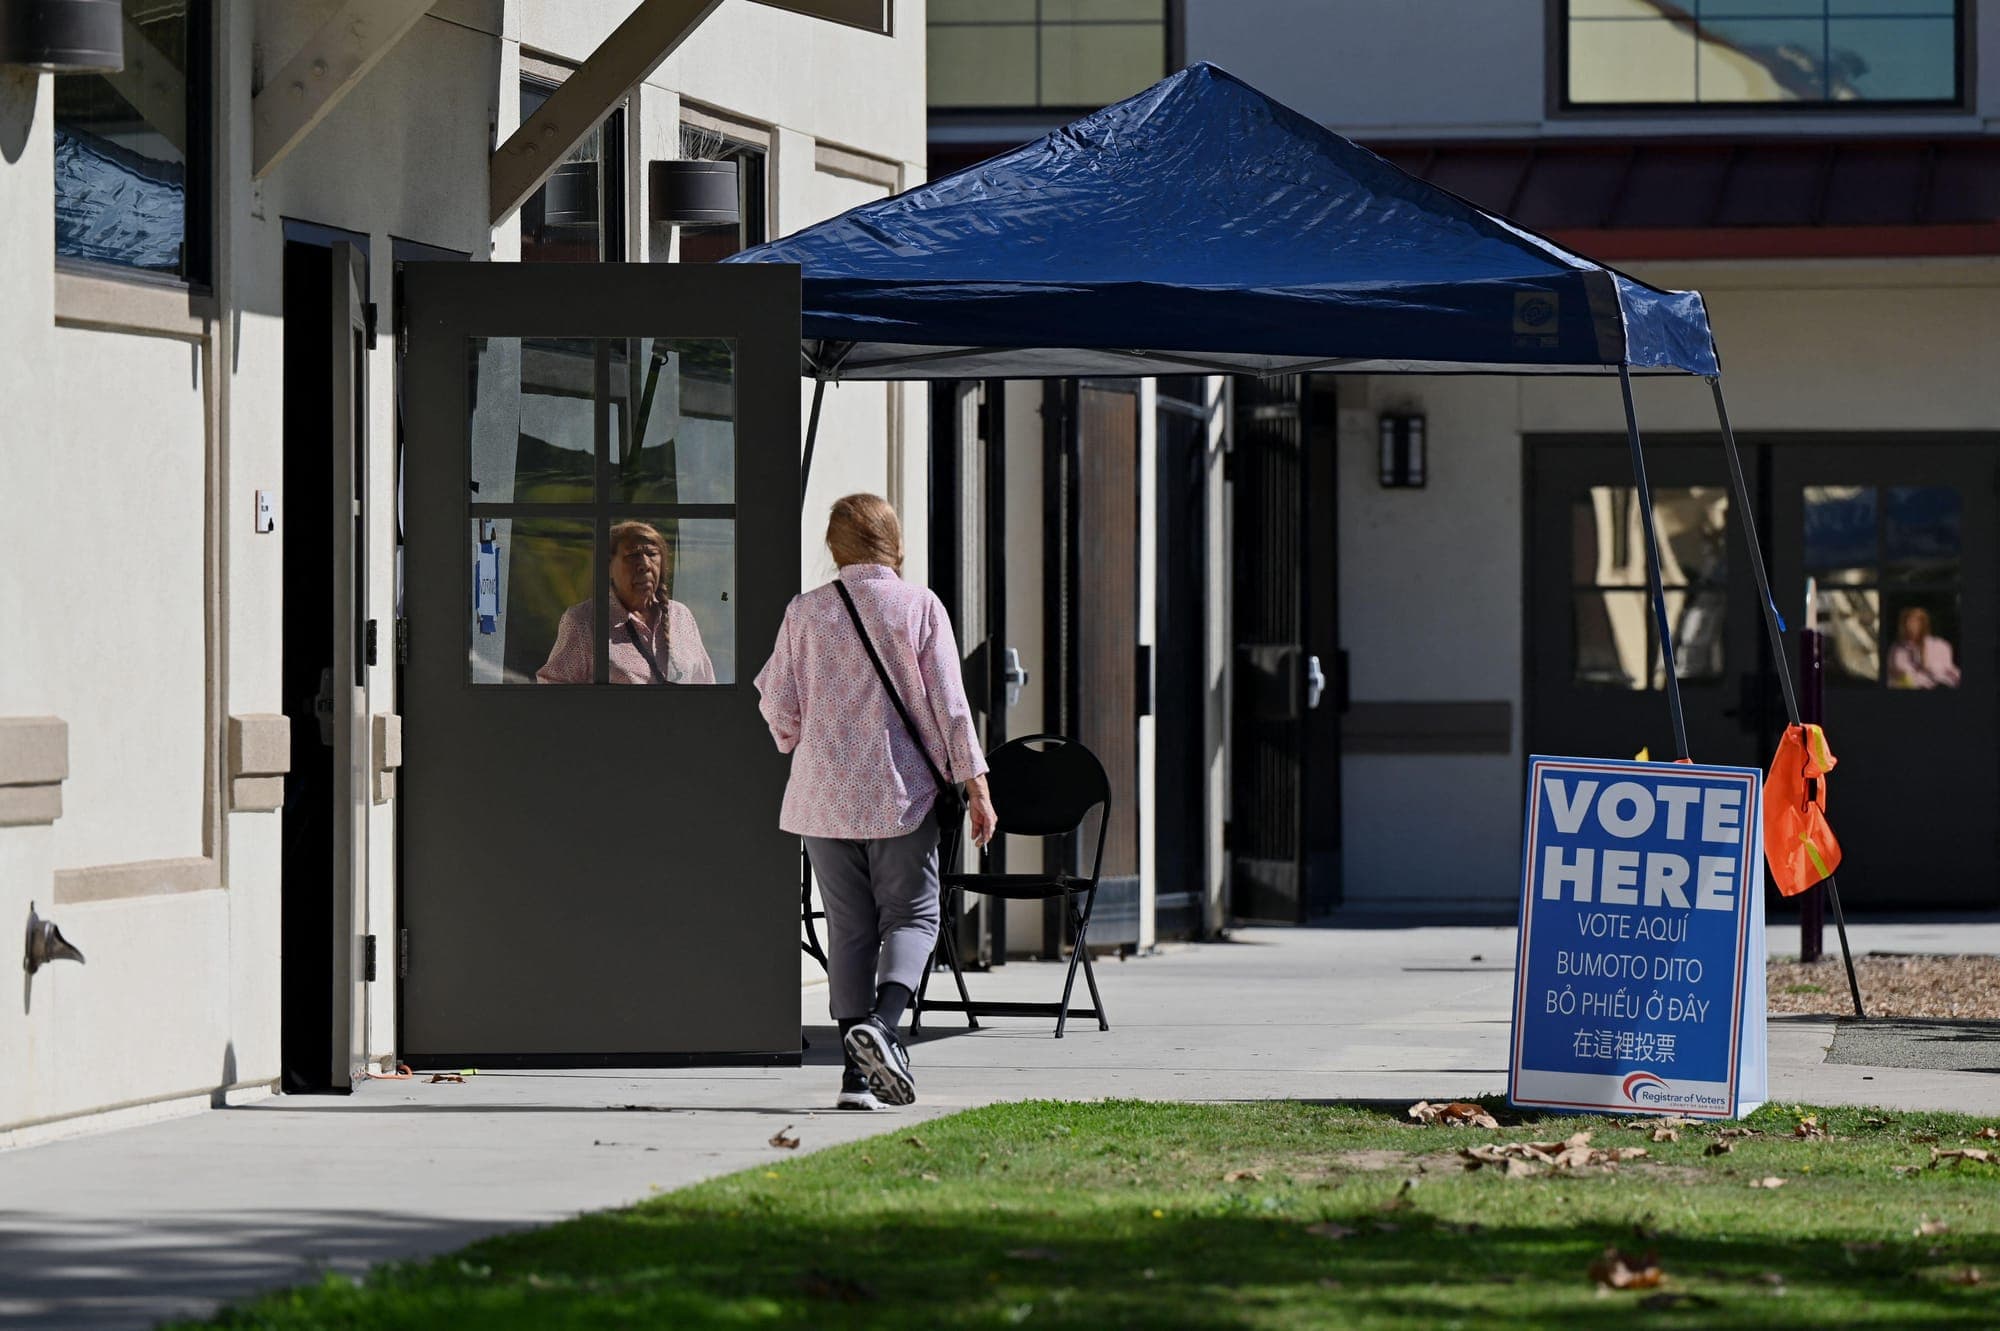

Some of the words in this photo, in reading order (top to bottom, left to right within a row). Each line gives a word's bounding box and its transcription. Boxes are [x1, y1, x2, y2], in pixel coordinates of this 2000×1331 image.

[1543, 778, 1742, 844] VOTE
[1542, 845, 1736, 912] HERE
[1577, 912, 1632, 939] VOTE
[1635, 913, 1689, 942] AQUÍ
[1557, 951, 1648, 980] BUMOTO
[1653, 957, 1703, 983] DITO
[1546, 984, 1576, 1015] BỎ
[1581, 987, 1640, 1019] PHIẾU
[1645, 989, 1664, 1020] Ở
[1667, 993, 1710, 1023] ĐÂY
[1572, 1028, 1677, 1063] 在這裡投票
[1642, 1091, 1684, 1103] Registrar
[1684, 1094, 1695, 1103] of
[1695, 1094, 1726, 1105] Voters
